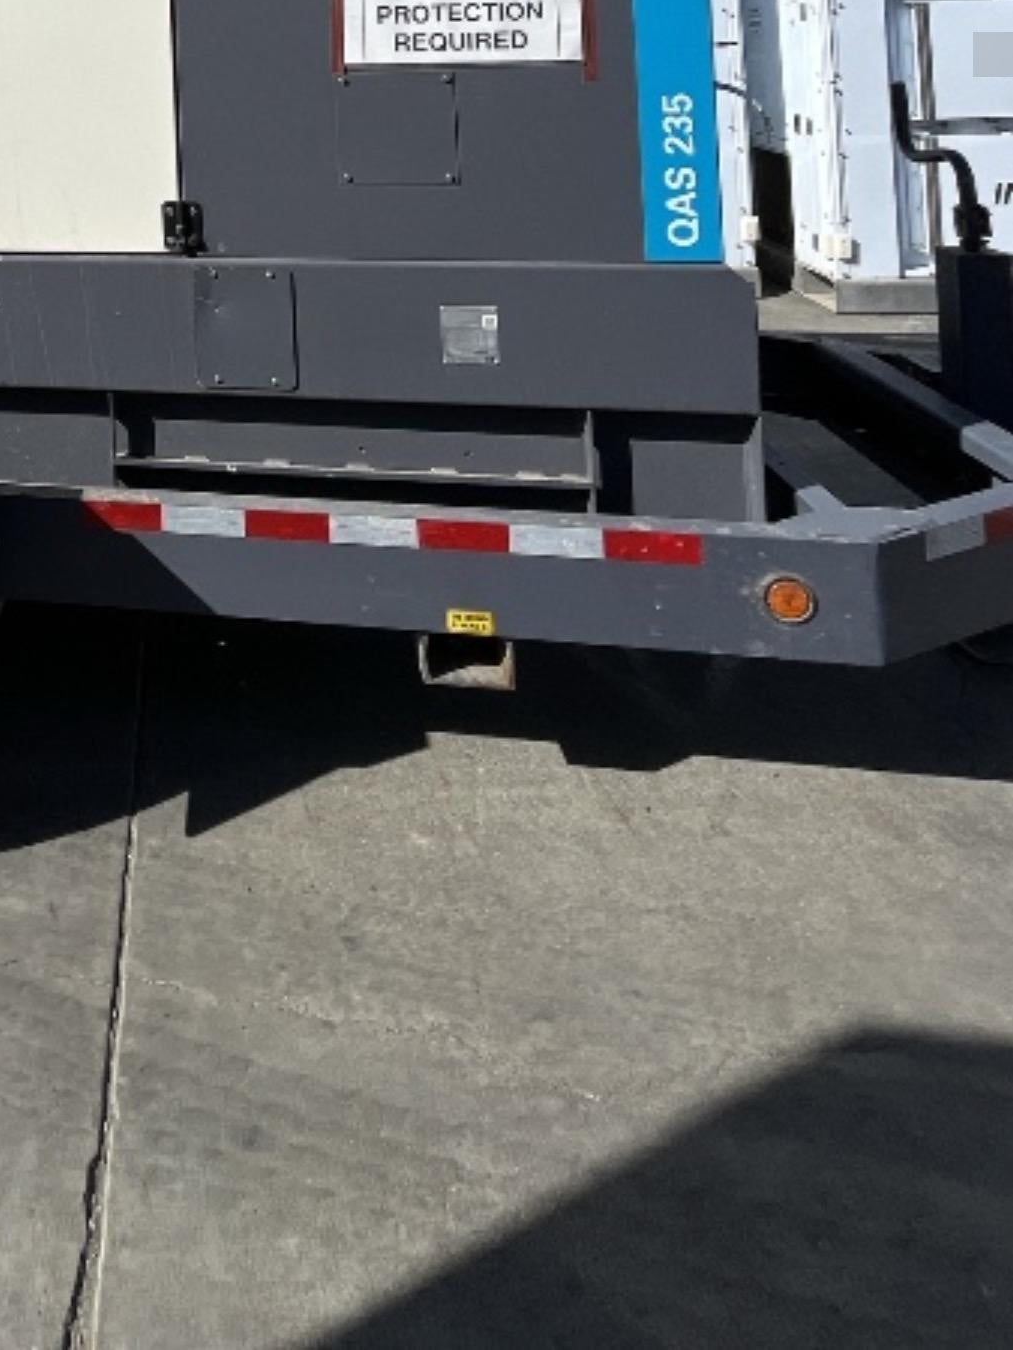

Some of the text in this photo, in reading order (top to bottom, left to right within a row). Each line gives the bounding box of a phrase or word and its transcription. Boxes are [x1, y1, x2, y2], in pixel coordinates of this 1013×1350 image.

[376, 1, 544, 26] PROTECTION
[394, 29, 528, 53] REQUIRED
[661, 92, 700, 248] QAS 235
